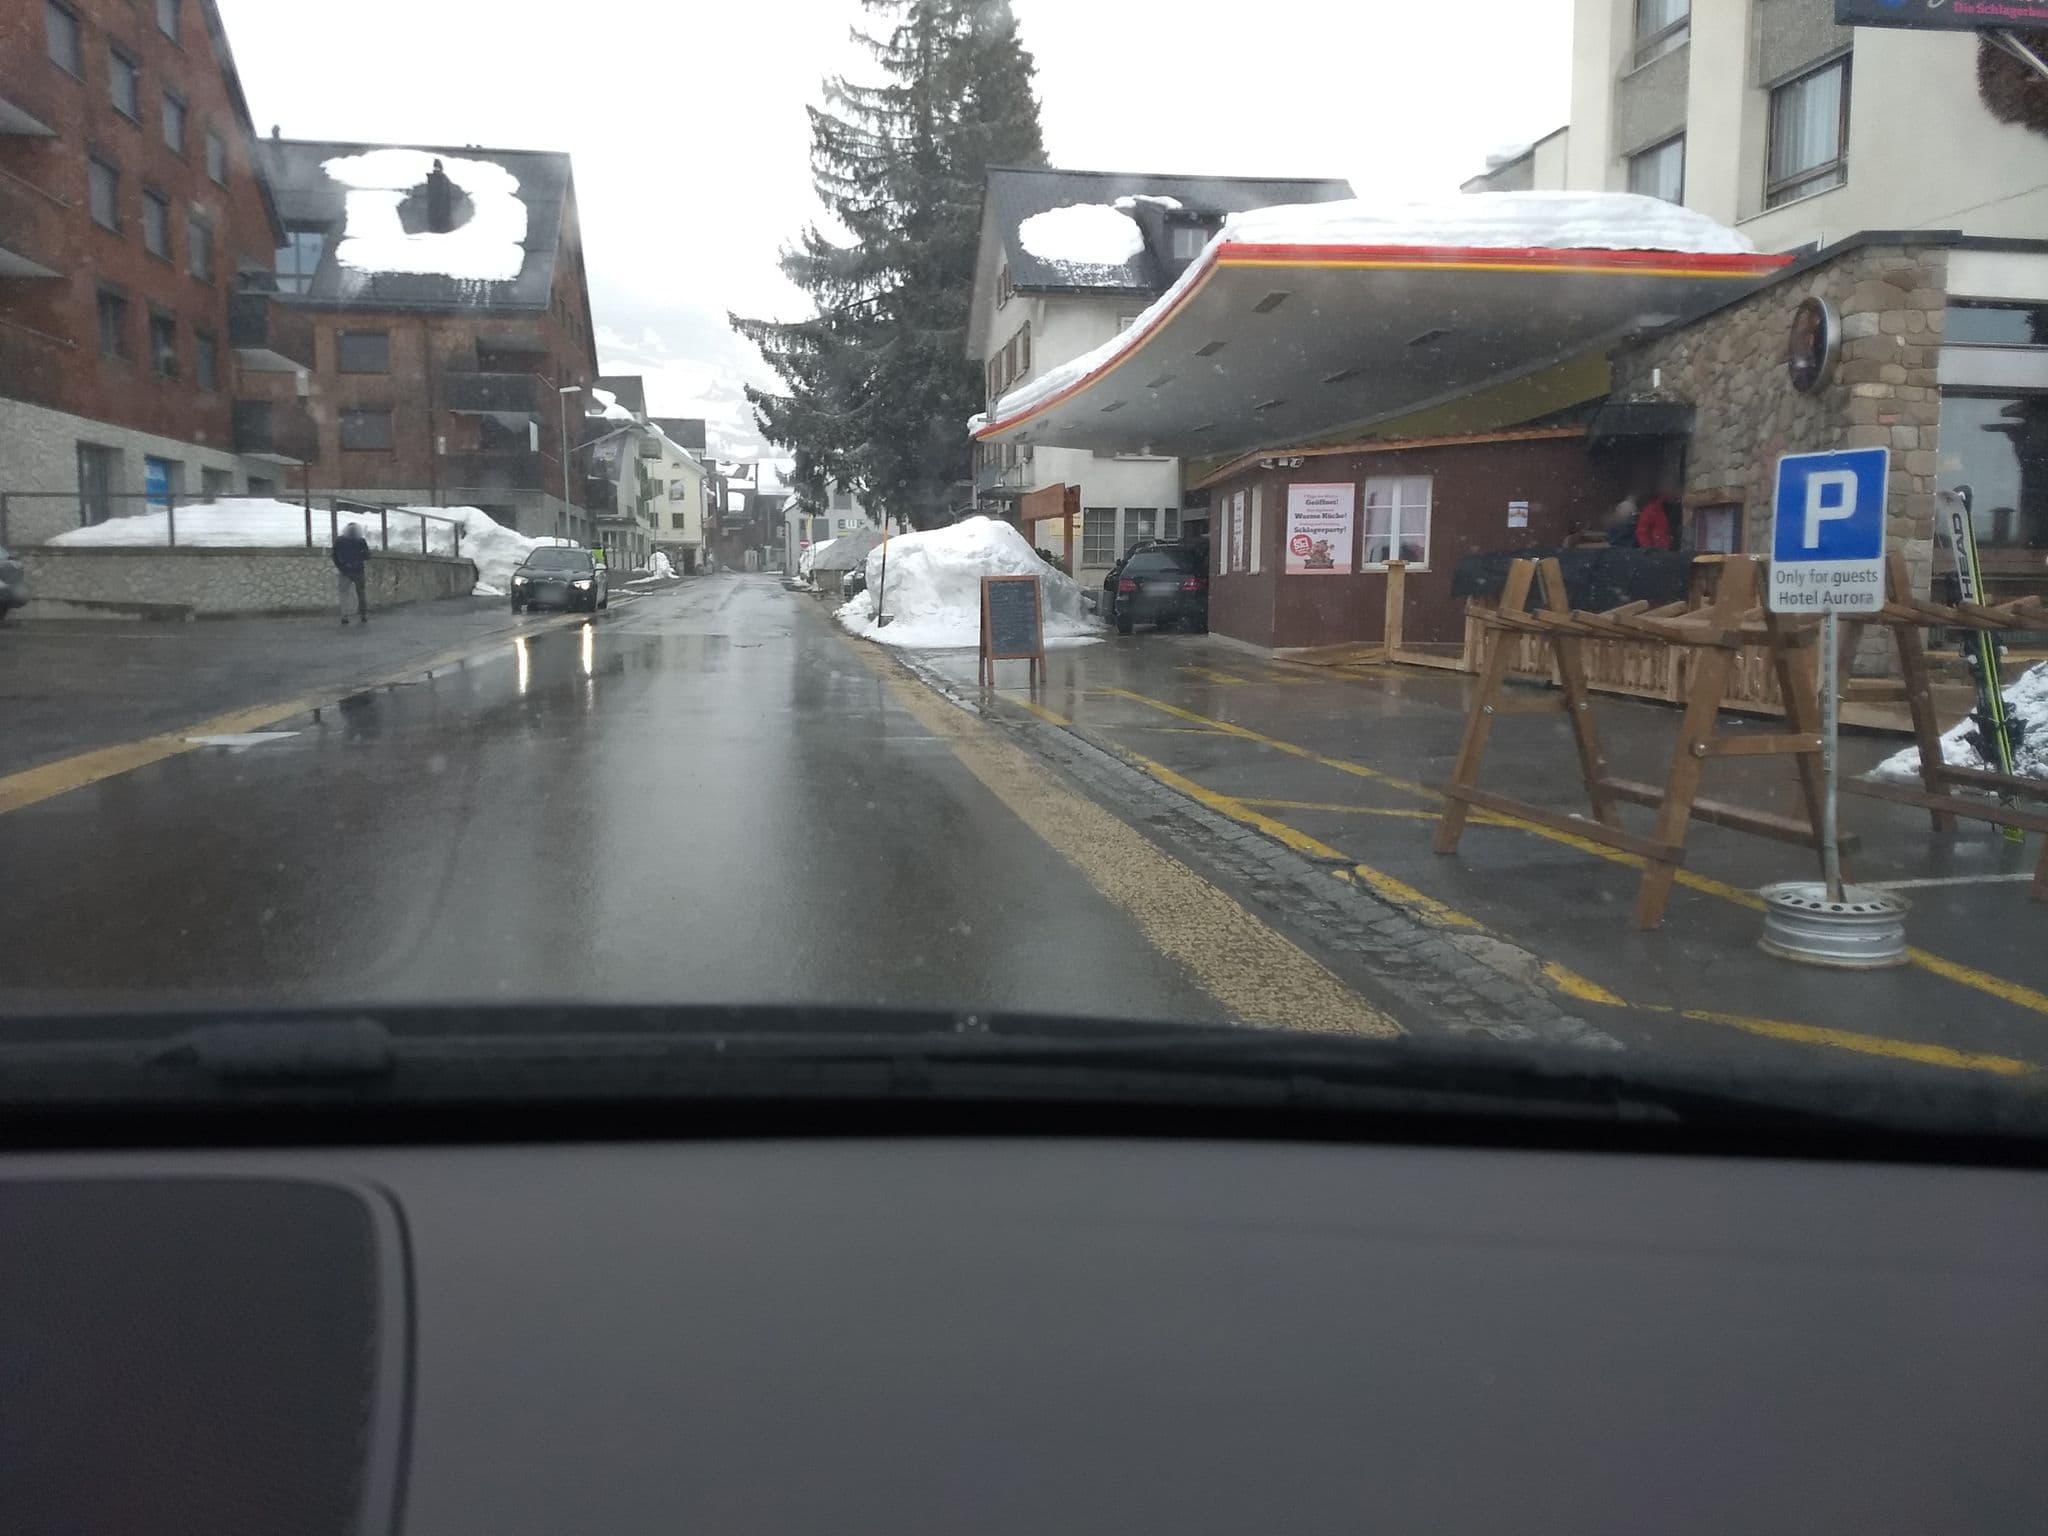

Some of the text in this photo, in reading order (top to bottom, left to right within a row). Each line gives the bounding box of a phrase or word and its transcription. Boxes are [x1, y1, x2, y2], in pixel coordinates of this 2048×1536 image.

[1954, 2, 1976, 14] Die
[1804, 470, 1858, 549] P
[1952, 512, 1973, 599] HEAD
[1776, 568, 1878, 587] Only for guests
[1779, 590, 1874, 605] Hotel Aurora
